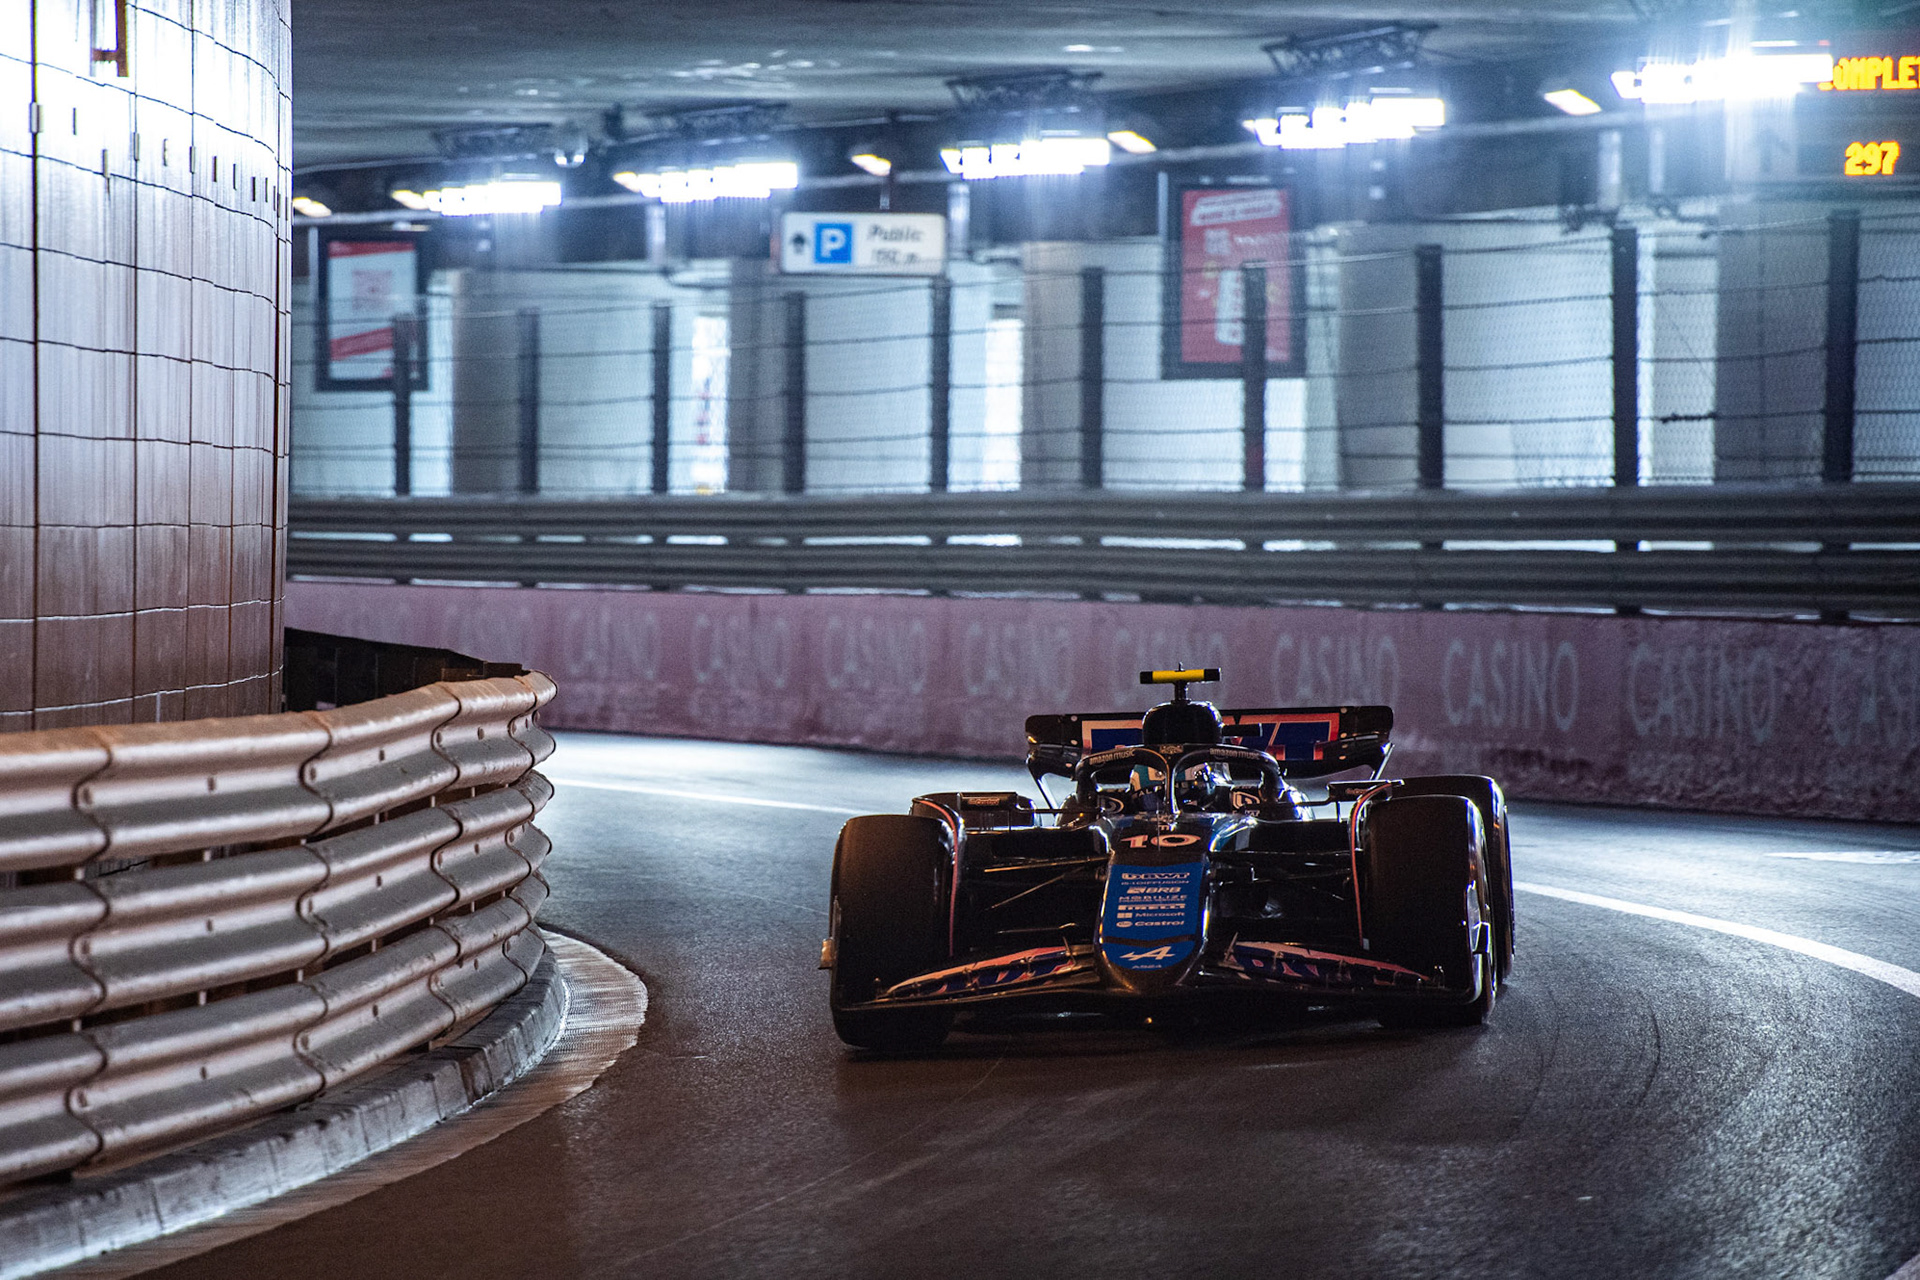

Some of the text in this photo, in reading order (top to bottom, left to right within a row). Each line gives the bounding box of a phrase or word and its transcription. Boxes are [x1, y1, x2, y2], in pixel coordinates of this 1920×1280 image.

[1818, 56, 1920, 90] OMPLE
[1844, 140, 1900, 175] 297
[820, 228, 846, 258] P
[1271, 632, 1397, 709] CASINO
[1441, 637, 1578, 734] CASINO
[1627, 640, 1777, 742] CASINO
[1089, 748, 1136, 766] amazon music
[1209, 748, 1260, 760] amazon music
[1120, 834, 1201, 848] 10
